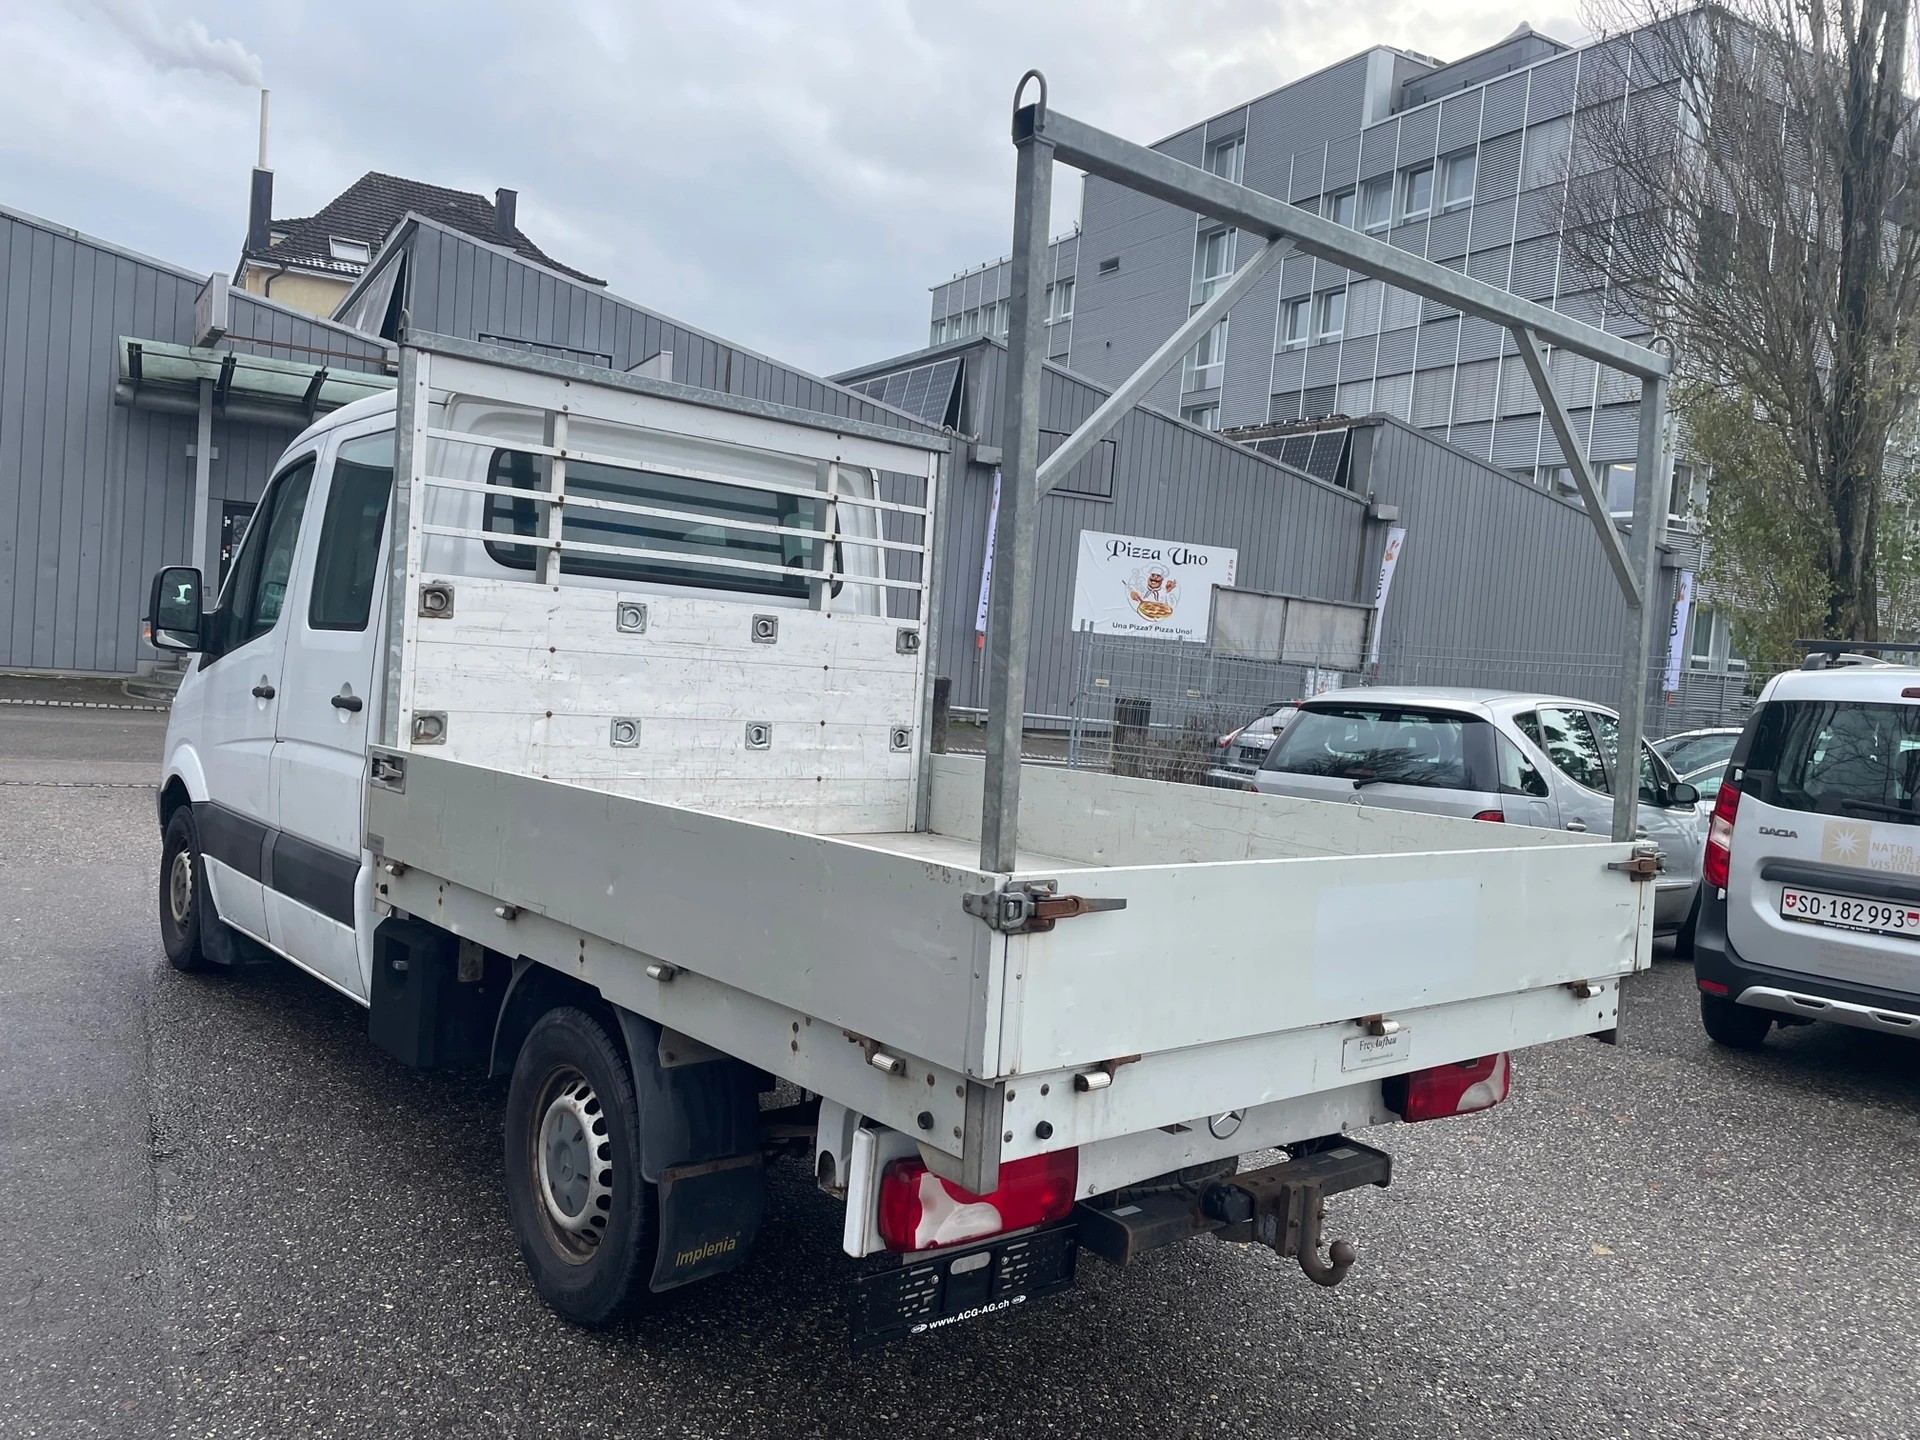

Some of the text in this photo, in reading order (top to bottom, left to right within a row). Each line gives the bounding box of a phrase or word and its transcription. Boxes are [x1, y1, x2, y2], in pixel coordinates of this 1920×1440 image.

[1106, 539, 1208, 566] Pizza Uno
[1112, 622, 1128, 630] Una
[1129, 623, 1153, 632] Pizza?
[1154, 625, 1174, 634] Pizza
[1759, 826, 1798, 838] DACIA
[1872, 842, 1913, 855] NATUR
[675, 1236, 736, 1267] Implenia
[929, 1299, 1010, 1330] www.ACG-AG.ch
